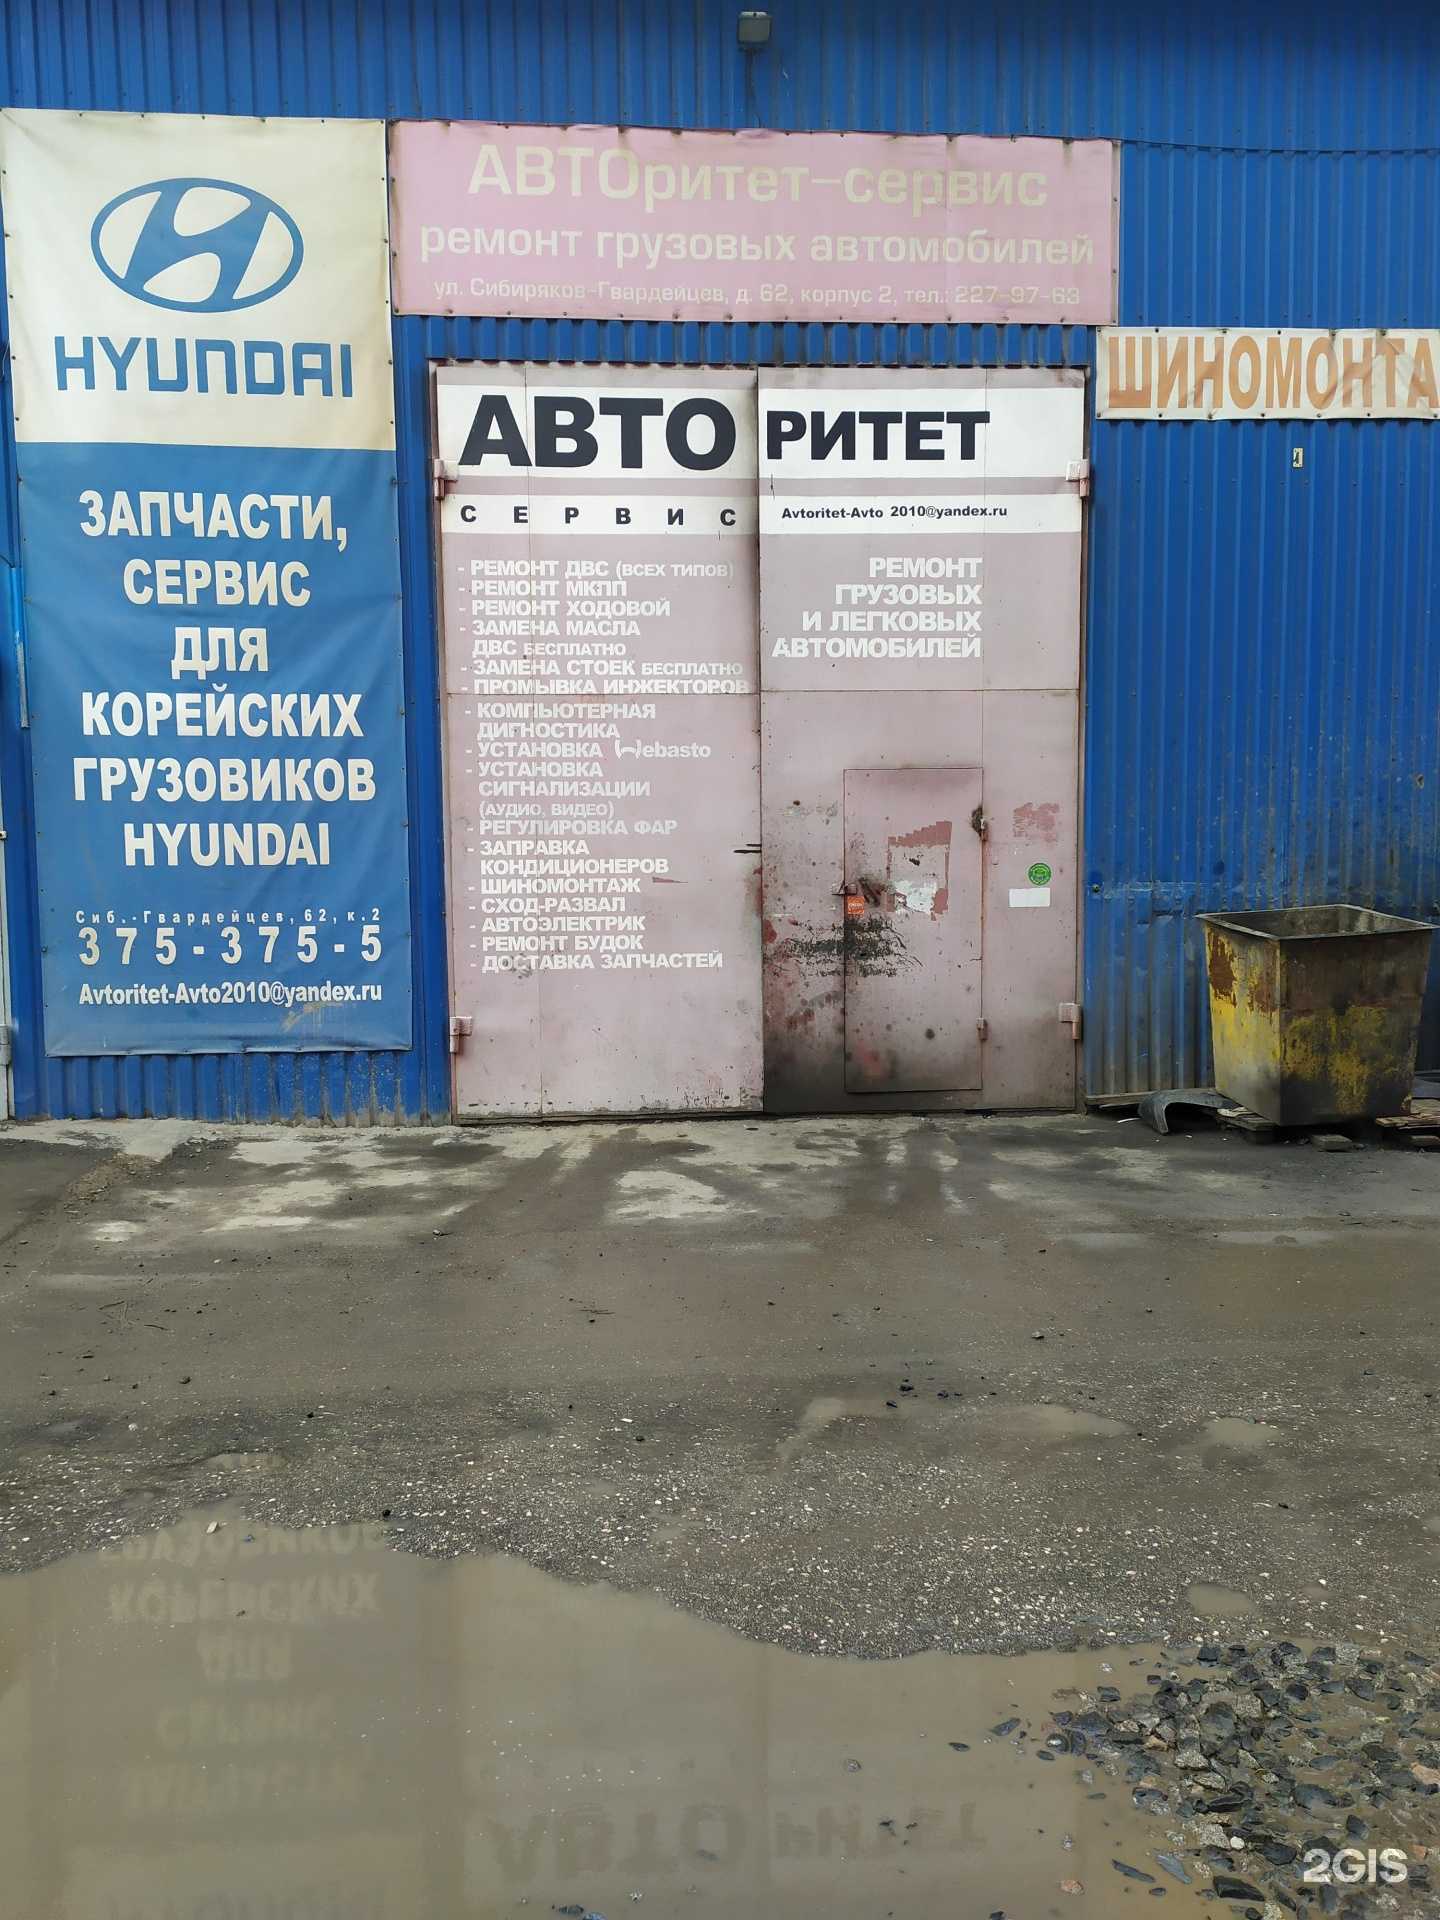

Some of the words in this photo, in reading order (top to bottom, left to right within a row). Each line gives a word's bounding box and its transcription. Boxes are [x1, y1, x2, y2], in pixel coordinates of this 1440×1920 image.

[420, 224, 584, 262] ремонт
[597, 231, 796, 268] грузовых
[811, 229, 1094, 265] автомобилей
[434, 281, 462, 299] ул.
[801, 287, 873, 307] корпус
[54, 336, 353, 398] HYUNDAI
[1108, 335, 1440, 410] ШИНОМОНТА
[458, 394, 737, 471] АВТО
[766, 410, 990, 460] РИТЕТ
[79, 489, 347, 552] ЗАПЧАСТИ,
[460, 505, 736, 526] СЕРВИС
[781, 507, 884, 520] Avtoritet-Avto
[890, 505, 1008, 519] 2010@yandex.ru
[471, 559, 559, 577] РЕМОНТ
[565, 560, 608, 579] ДВС
[616, 560, 666, 580] (ВСЕХ
[869, 557, 983, 578] РЕМОНТ
[123, 558, 311, 607] СЕРВИС
[471, 580, 559, 596] РЕМОНТ
[566, 580, 627, 596] МКПП
[835, 584, 983, 605] ГРУЗОВЫХ
[472, 600, 560, 616] РЕМОНТ
[566, 597, 671, 619] ХОДОВОЙ
[472, 620, 560, 636] ЗАМЕНА
[566, 620, 641, 636] МАСЛА
[802, 611, 822, 632] И
[830, 611, 982, 632] ЛЕГКОВЫХ
[171, 626, 269, 680] ДЛЯ
[472, 639, 517, 658] ДВС
[524, 643, 626, 657] БЕСПЛАТНО
[772, 633, 981, 658] АВТОМОБИЛЕЙ
[473, 659, 560, 676] ЗАМЕНА
[566, 659, 635, 676] СТОЕК
[642, 662, 743, 676] БЕСПЛАТНО
[474, 679, 600, 695] ПРОМЫВКА
[604, 679, 749, 695] ИНЖЕКТОРОВ
[81, 683, 365, 737] КОРЕЙСКИХ
[477, 702, 656, 719] КОМПЬЮТЕРНАЯ
[478, 742, 603, 758] УСТАНОВКА
[478, 761, 603, 777] УСТАНОВКА
[72, 757, 376, 803] ГРУЗОВИКОВ
[479, 780, 650, 799] СИГНАЛИЗАЦИИ
[479, 820, 628, 836] РЕГУЛИРОВКА
[634, 820, 678, 836] ФАР
[123, 823, 330, 866] HYUNDAI
[480, 840, 590, 856] ЗАПРАВКА
[480, 859, 670, 878] КОНДИЦИОНЕРОВ
[480, 878, 641, 895] ШИНОМОНТАЖ
[481, 897, 626, 915] СХОД-РАЗВАЛ
[481, 916, 646, 932] АВТОЭЛЕКТРИК
[482, 936, 568, 951] РЕМОНТ
[575, 935, 644, 953] БУДОК
[482, 954, 595, 973] ДОСТАВКА
[601, 950, 723, 969] ЗАПЧАСТЕЙ
[79, 981, 383, 1008] Avtoritet-Avto2010@yandex.ru
